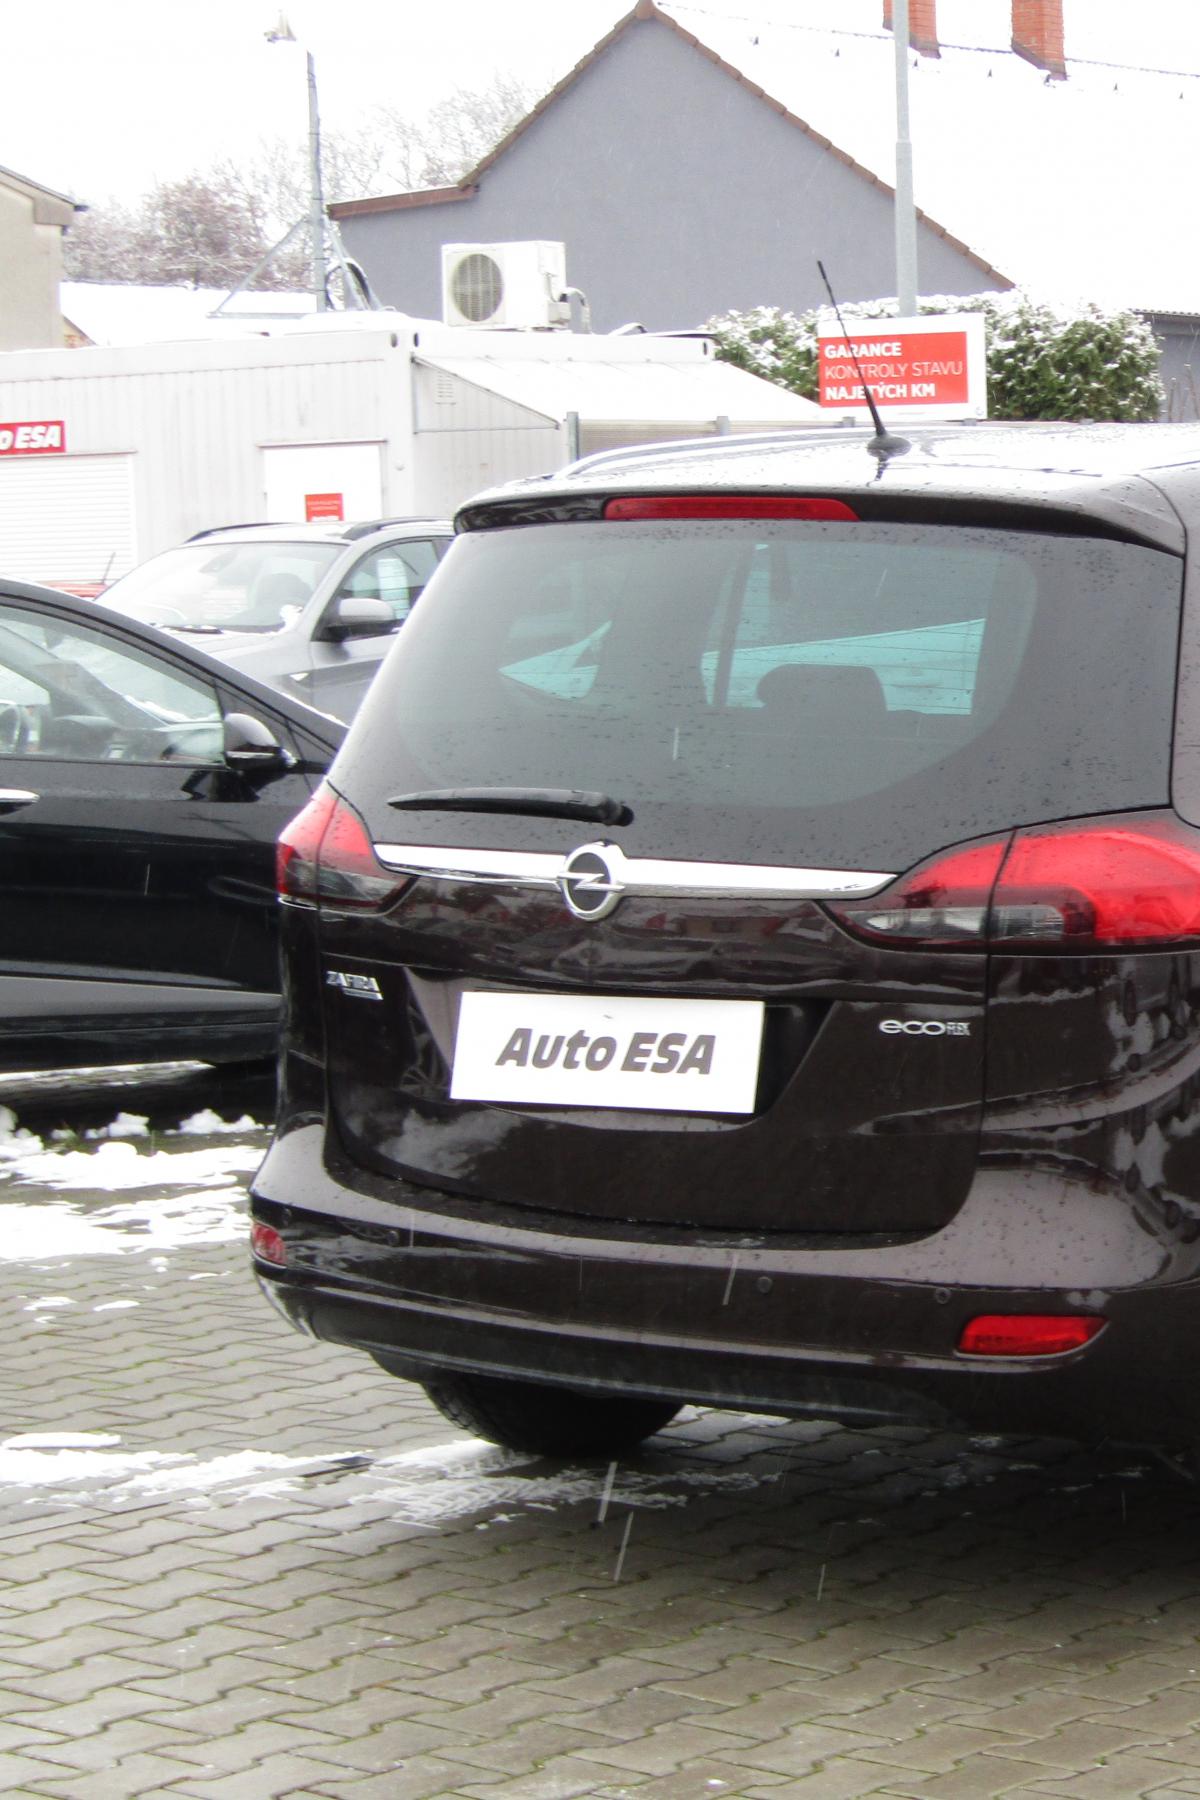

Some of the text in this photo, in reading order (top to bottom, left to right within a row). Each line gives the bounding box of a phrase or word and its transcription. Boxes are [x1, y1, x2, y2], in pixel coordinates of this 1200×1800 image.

[824, 342, 902, 358] GARANCE
[824, 361, 964, 380] KONTROLY STAVU
[825, 381, 936, 400] NAJETÝCH KM
[15, 425, 61, 449] ESA
[495, 1026, 716, 1076] Auto ESA
